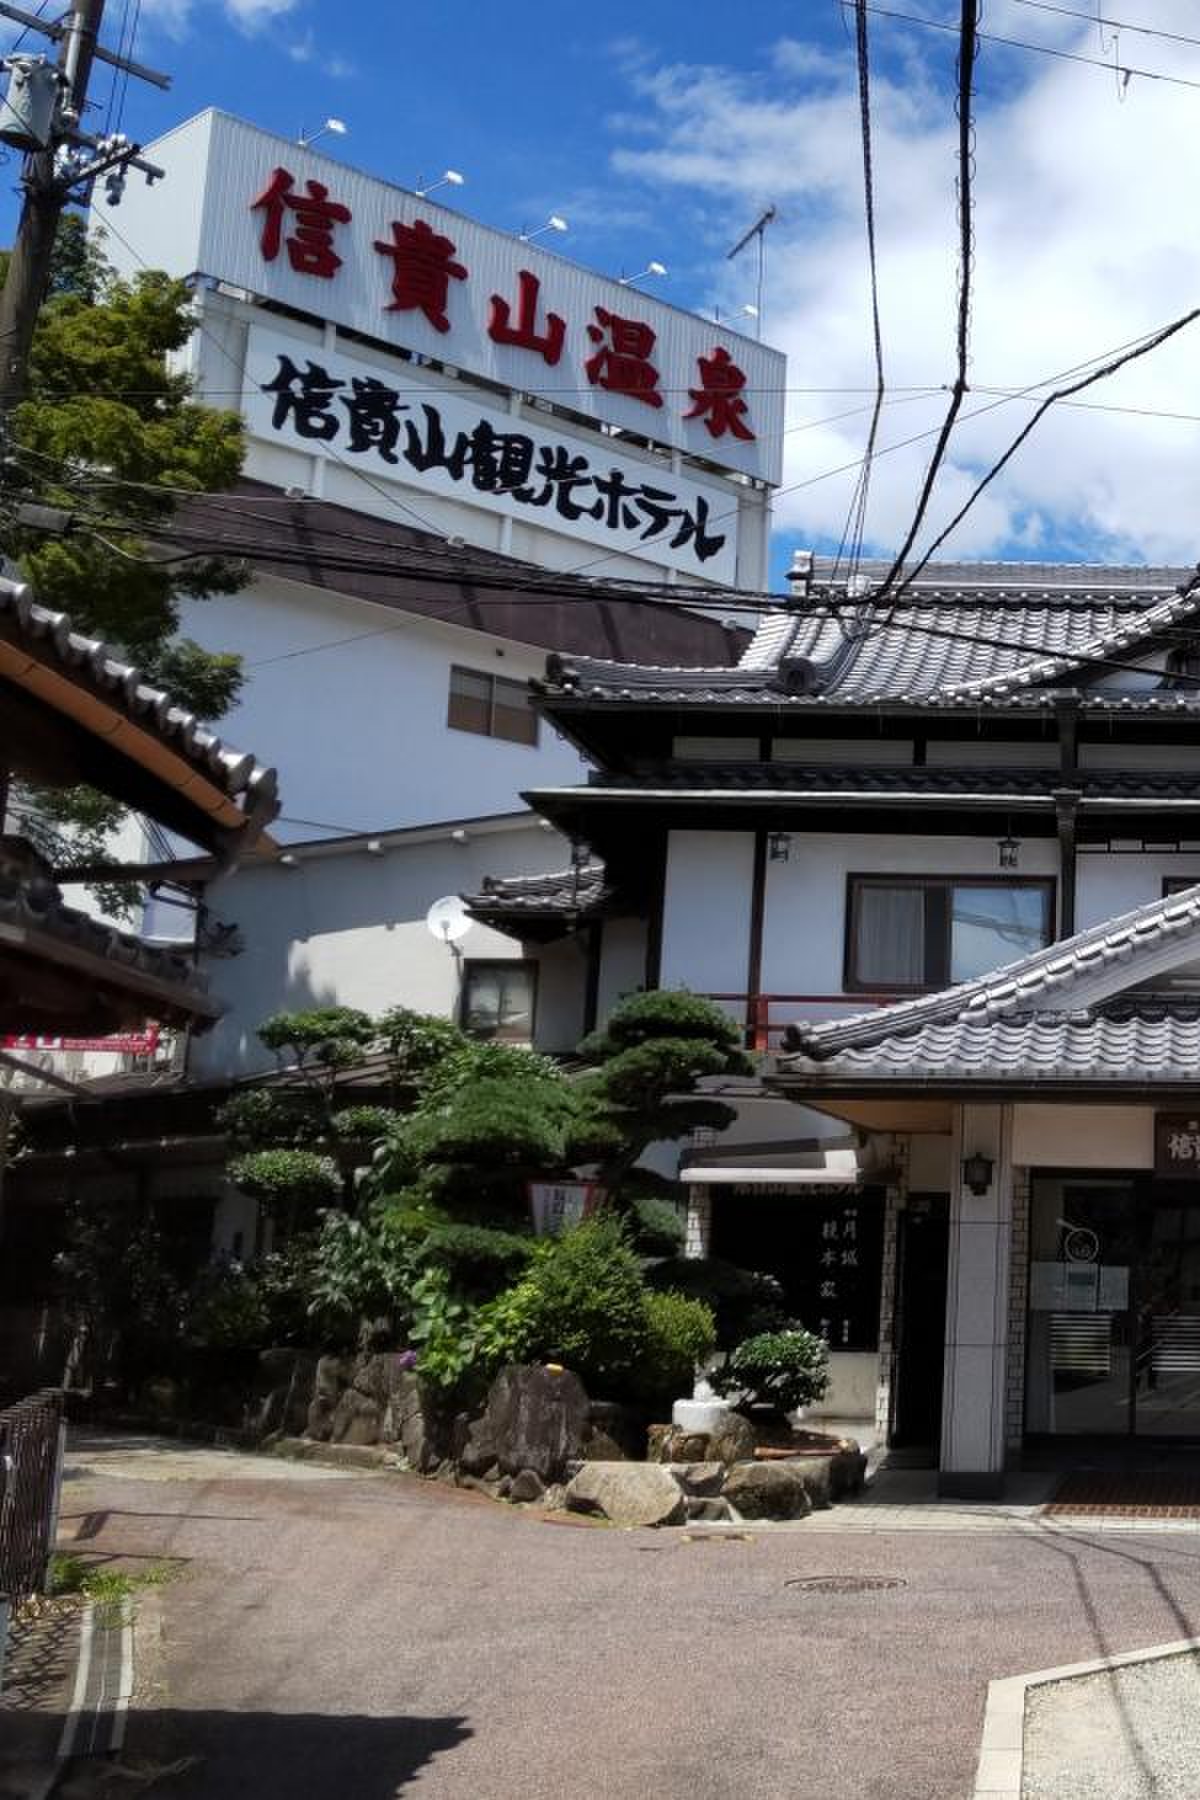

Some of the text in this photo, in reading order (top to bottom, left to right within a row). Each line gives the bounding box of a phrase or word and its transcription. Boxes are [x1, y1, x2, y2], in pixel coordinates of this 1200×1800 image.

[251, 166, 756, 441] 信貴山温泉
[262, 354, 728, 562] 信貴山観光ホテル
